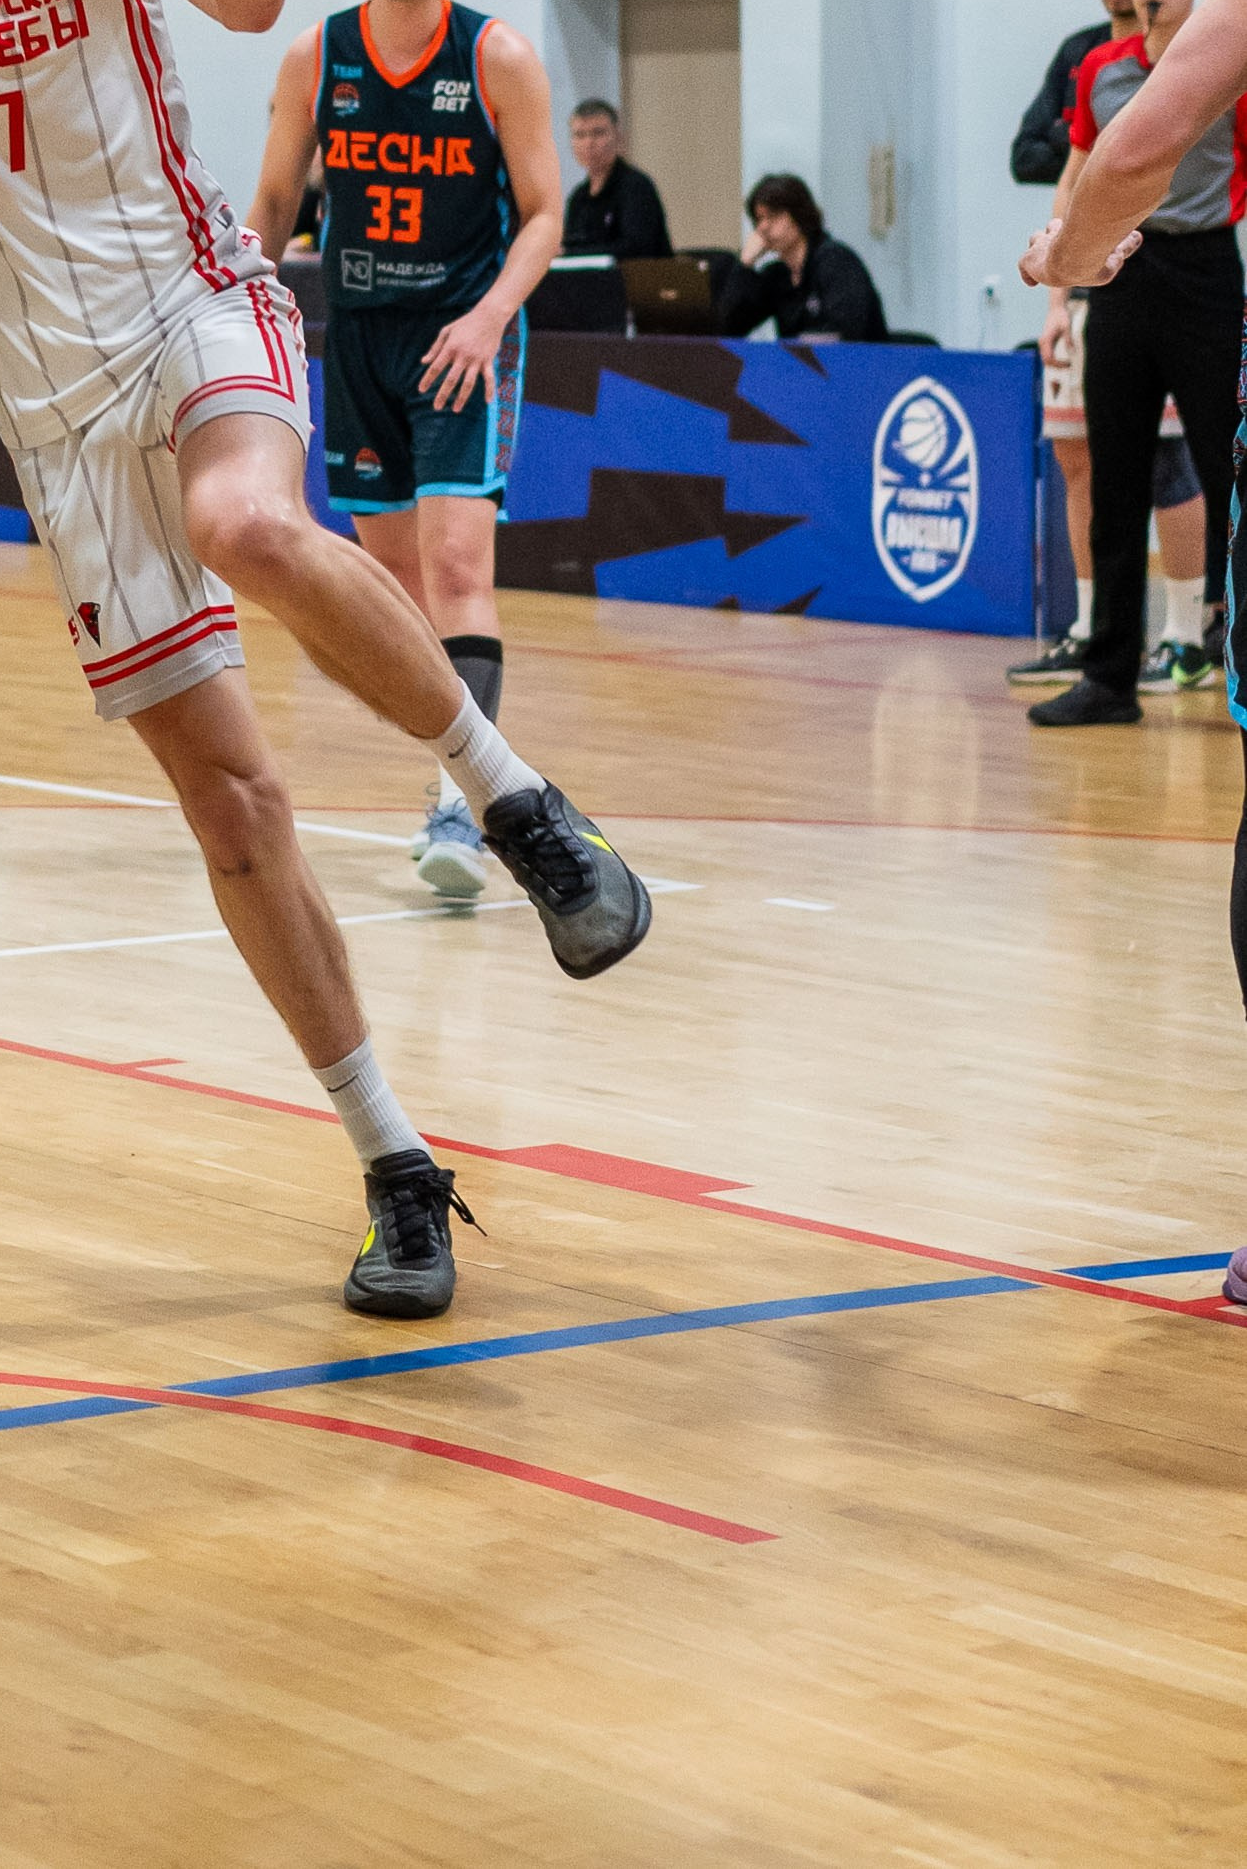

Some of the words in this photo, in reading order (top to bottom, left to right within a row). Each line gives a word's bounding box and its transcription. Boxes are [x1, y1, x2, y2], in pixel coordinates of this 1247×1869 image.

[433, 80, 471, 97] FON
[432, 95, 471, 112] BET
[325, 129, 476, 176] ДЕСНА
[365, 185, 423, 243] 33
[376, 262, 446, 276] НАДЕЖДА
